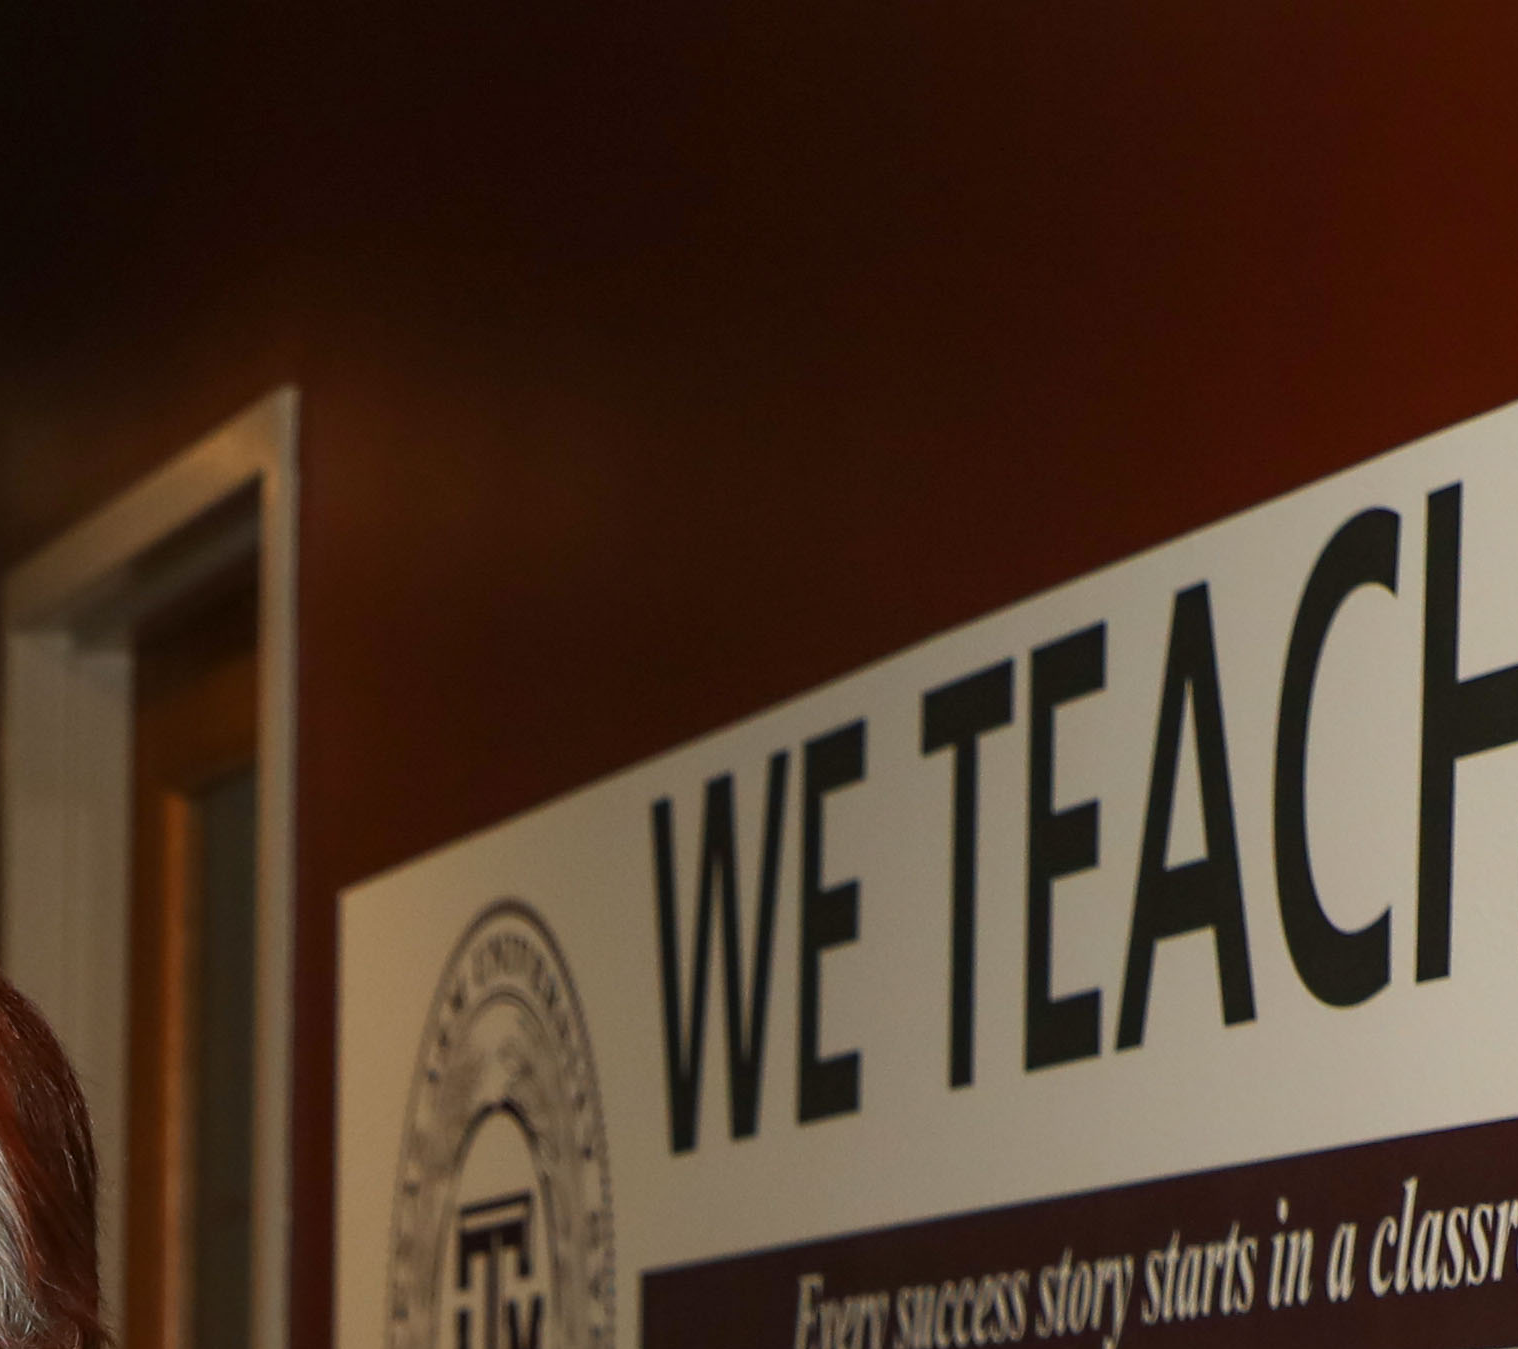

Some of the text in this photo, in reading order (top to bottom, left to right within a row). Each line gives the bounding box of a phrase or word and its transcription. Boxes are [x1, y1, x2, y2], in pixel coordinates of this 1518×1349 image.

[648, 717, 869, 1158] WE
[1143, 1226, 1258, 1322] starts
[1267, 1199, 1316, 1309] in
[1326, 1224, 1358, 1301] a
